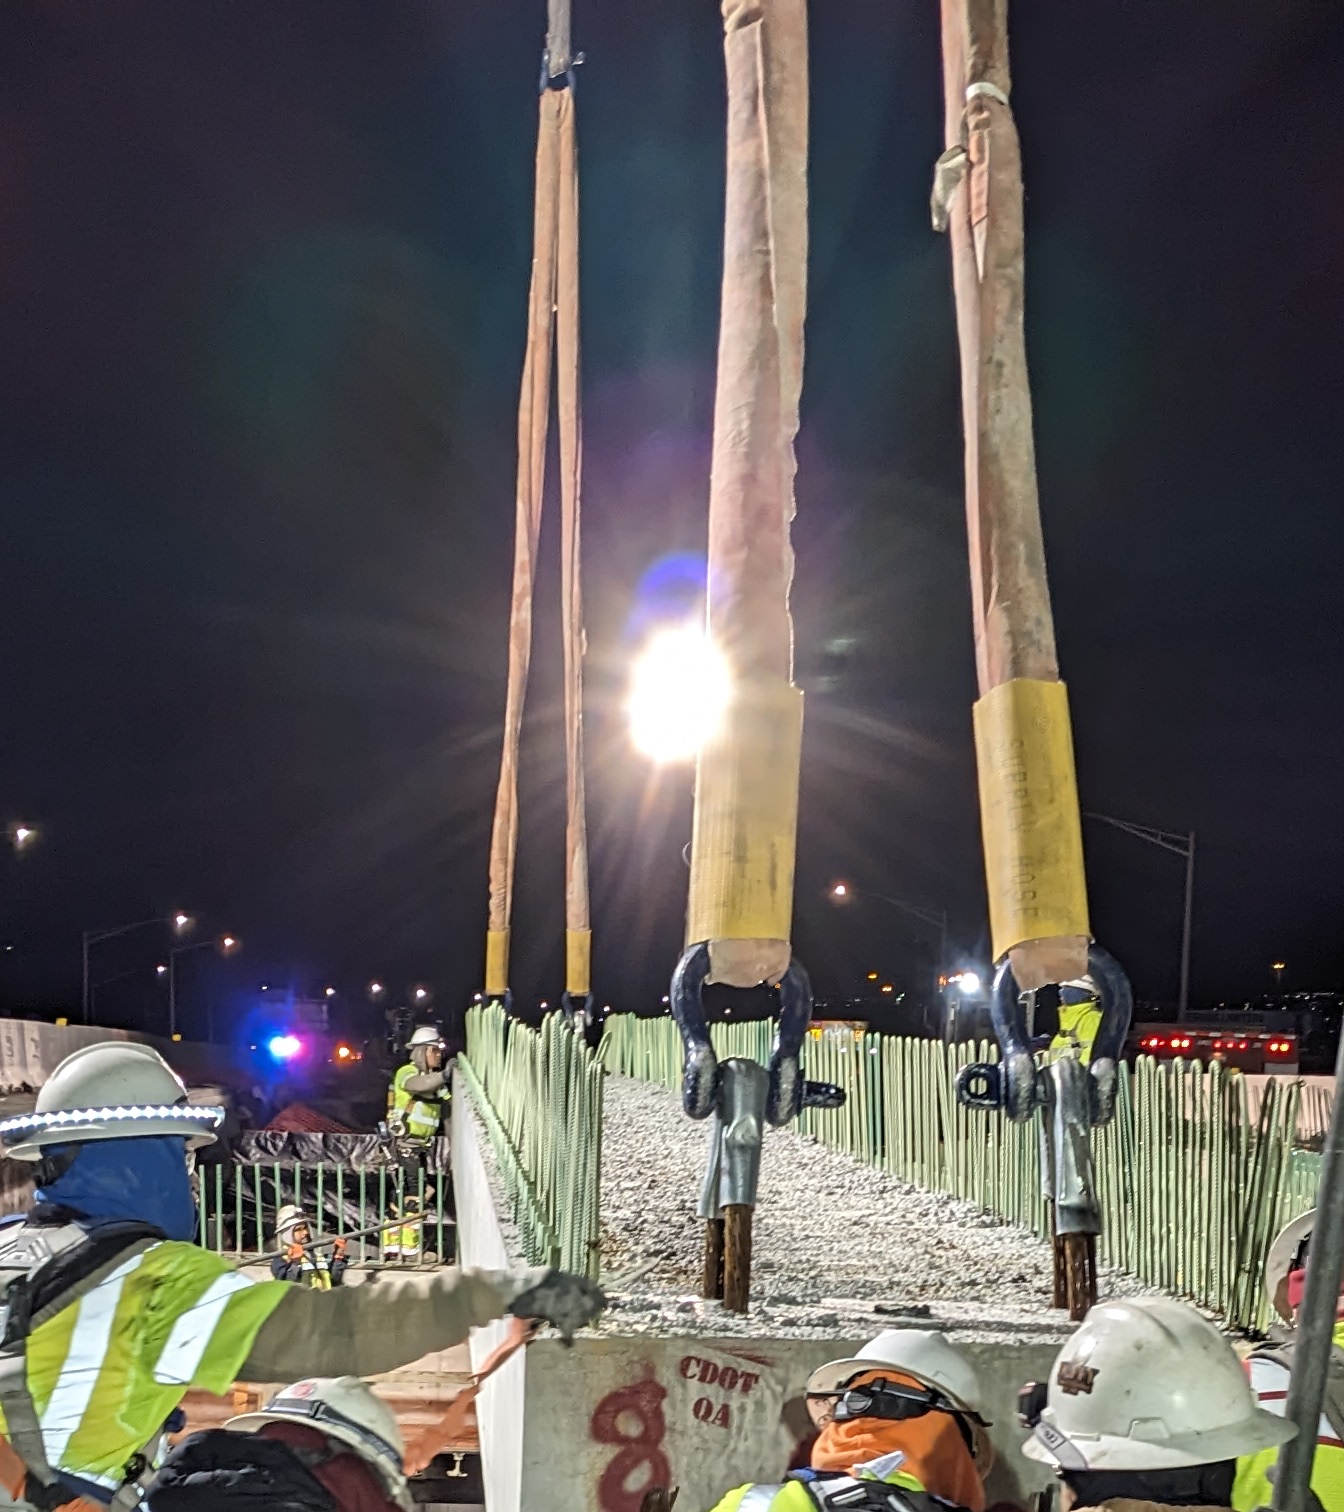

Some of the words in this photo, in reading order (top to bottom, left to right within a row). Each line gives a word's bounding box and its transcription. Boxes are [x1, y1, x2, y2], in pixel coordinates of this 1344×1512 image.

[1012, 854, 1039, 919] HOSE
[679, 1355, 760, 1393] CDOT
[693, 1397, 731, 1429] QA
